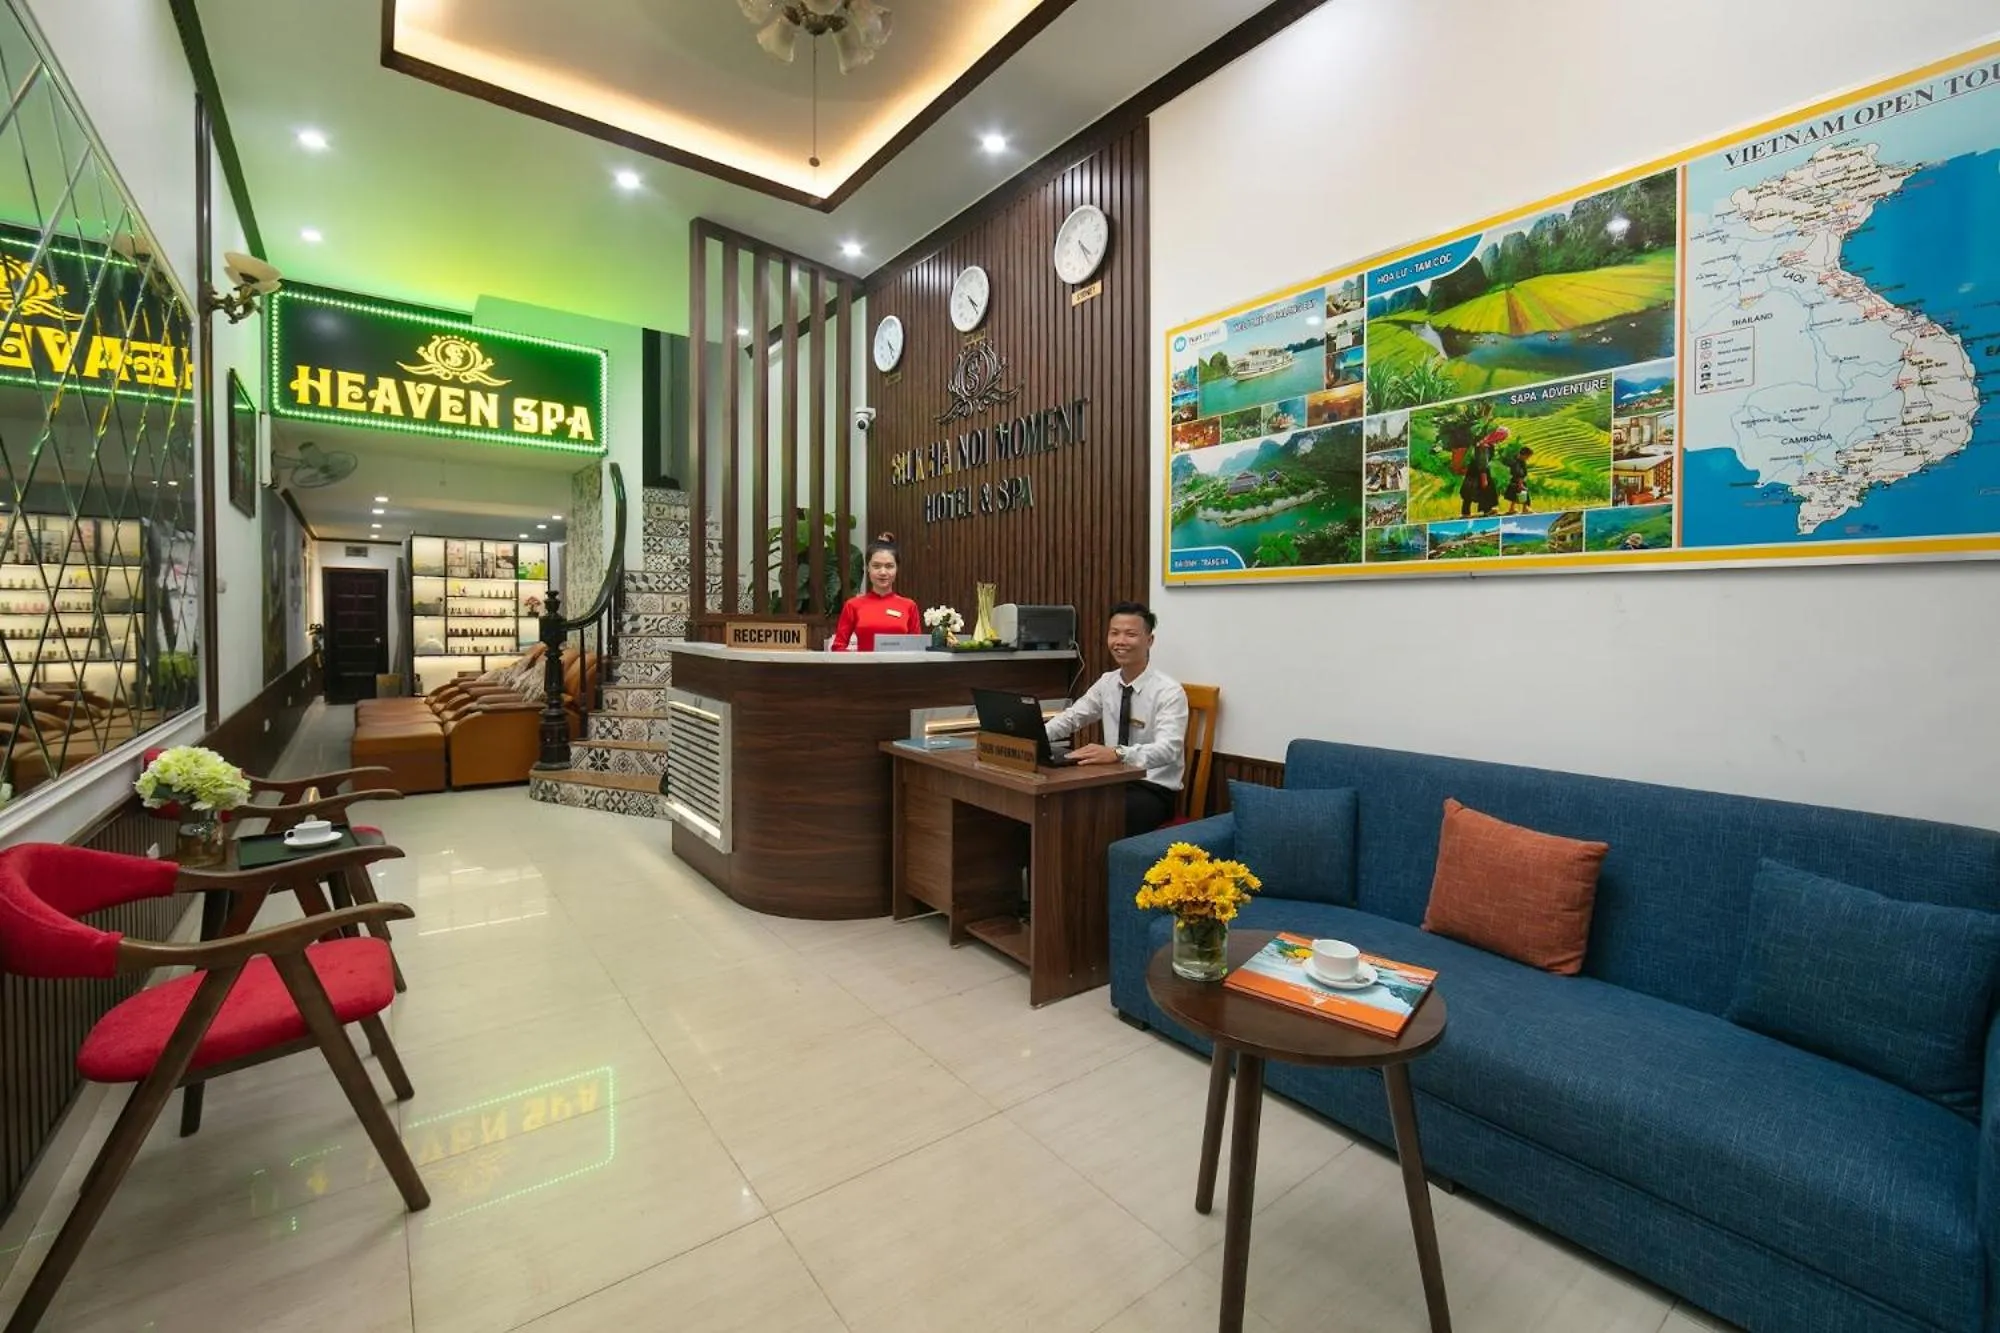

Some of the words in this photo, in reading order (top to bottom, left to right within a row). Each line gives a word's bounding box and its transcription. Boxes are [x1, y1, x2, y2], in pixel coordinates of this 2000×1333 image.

[1724, 115, 1845, 167] VIETNAM
[1854, 85, 1935, 125] OPEN
[1732, 312, 1773, 327] THAILAND
[290, 365, 499, 429] HEAVEN
[513, 397, 594, 441] SPA
[1509, 391, 1537, 405] SAPA
[1541, 378, 1608, 400] ADVENTURE
[892, 447, 925, 486] SILK
[929, 439, 952, 478] HA
[958, 428, 989, 471] NOI
[995, 397, 1090, 462] MOMENT
[1780, 432, 1832, 446] CAMBODIA
[926, 484, 973, 523] HOTEL
[980, 482, 993, 513] &
[998, 474, 1034, 511] SPA
[733, 628, 801, 644] RECEPTION
